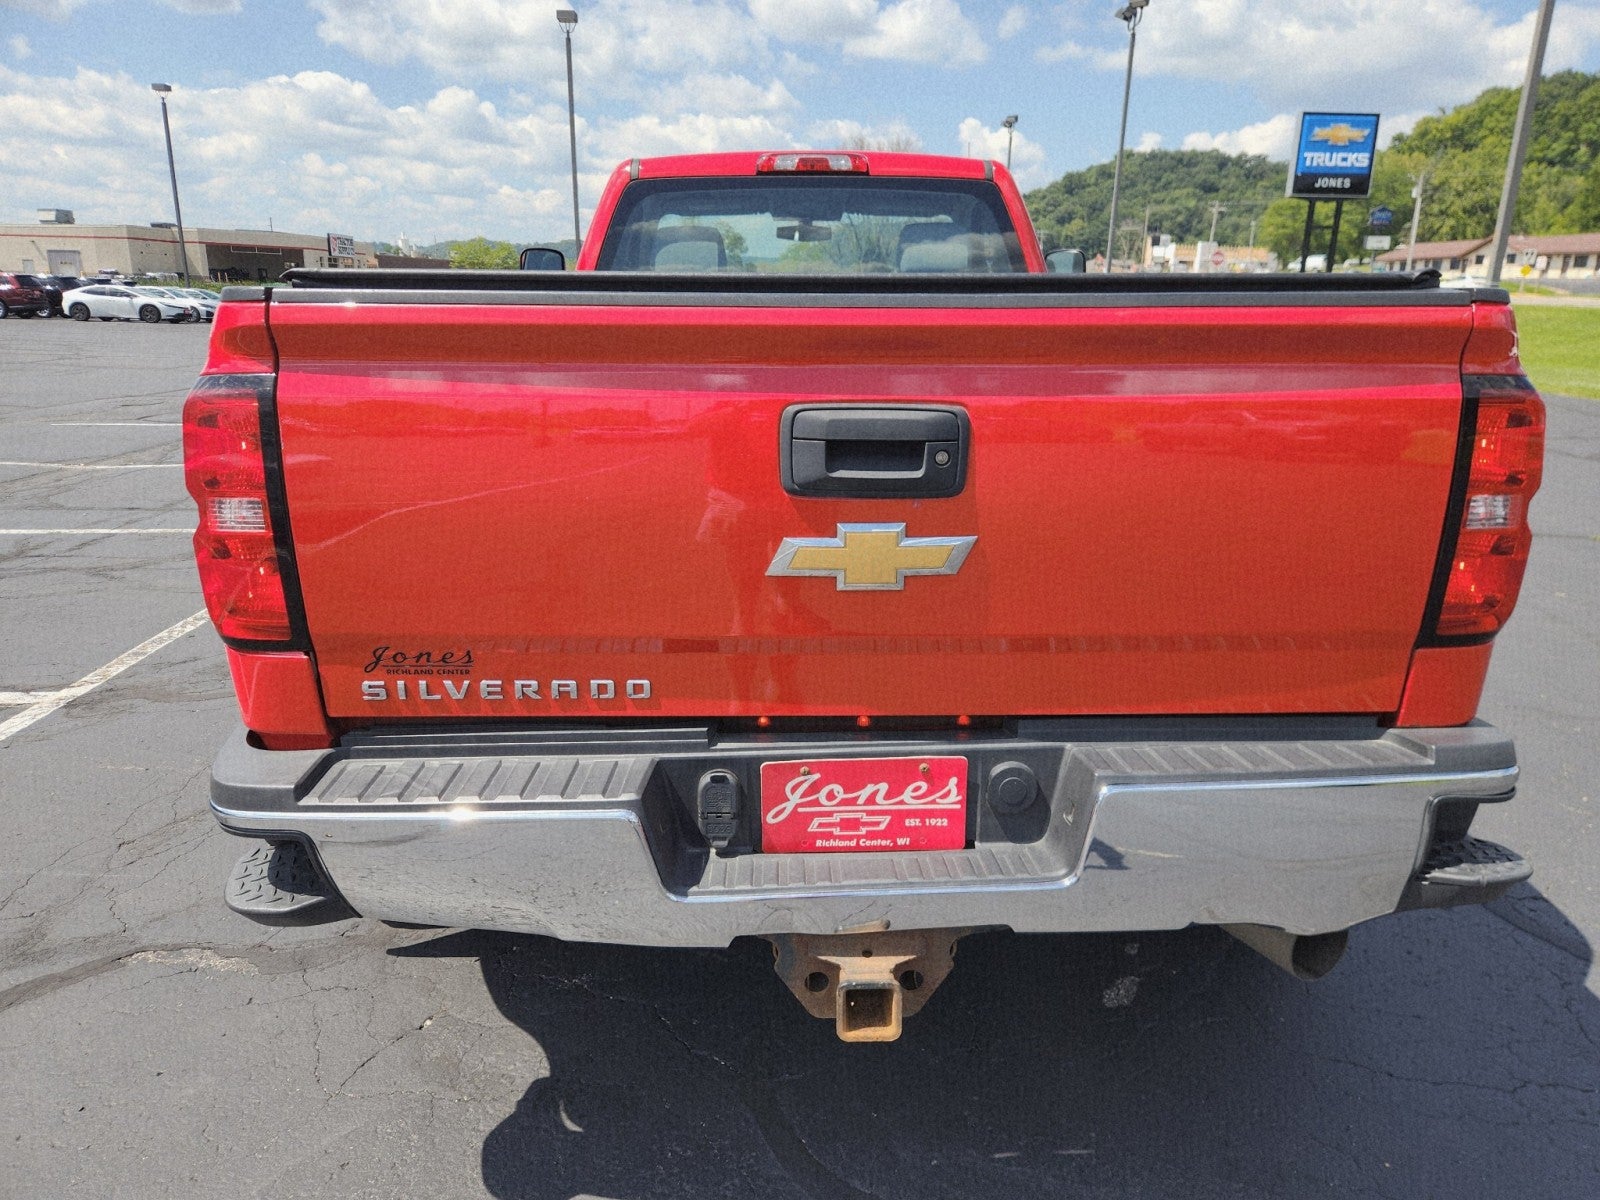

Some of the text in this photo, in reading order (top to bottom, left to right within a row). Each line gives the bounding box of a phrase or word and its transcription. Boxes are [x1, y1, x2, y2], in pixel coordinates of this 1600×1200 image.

[1303, 151, 1370, 168] TRUCKS
[1314, 177, 1351, 188] JONES
[364, 646, 474, 673] Jones
[361, 679, 651, 700] SILVERADO
[766, 773, 962, 824] Jones
[905, 818, 948, 826] EST. 1922
[815, 837, 910, 847] Richland Center, WI
